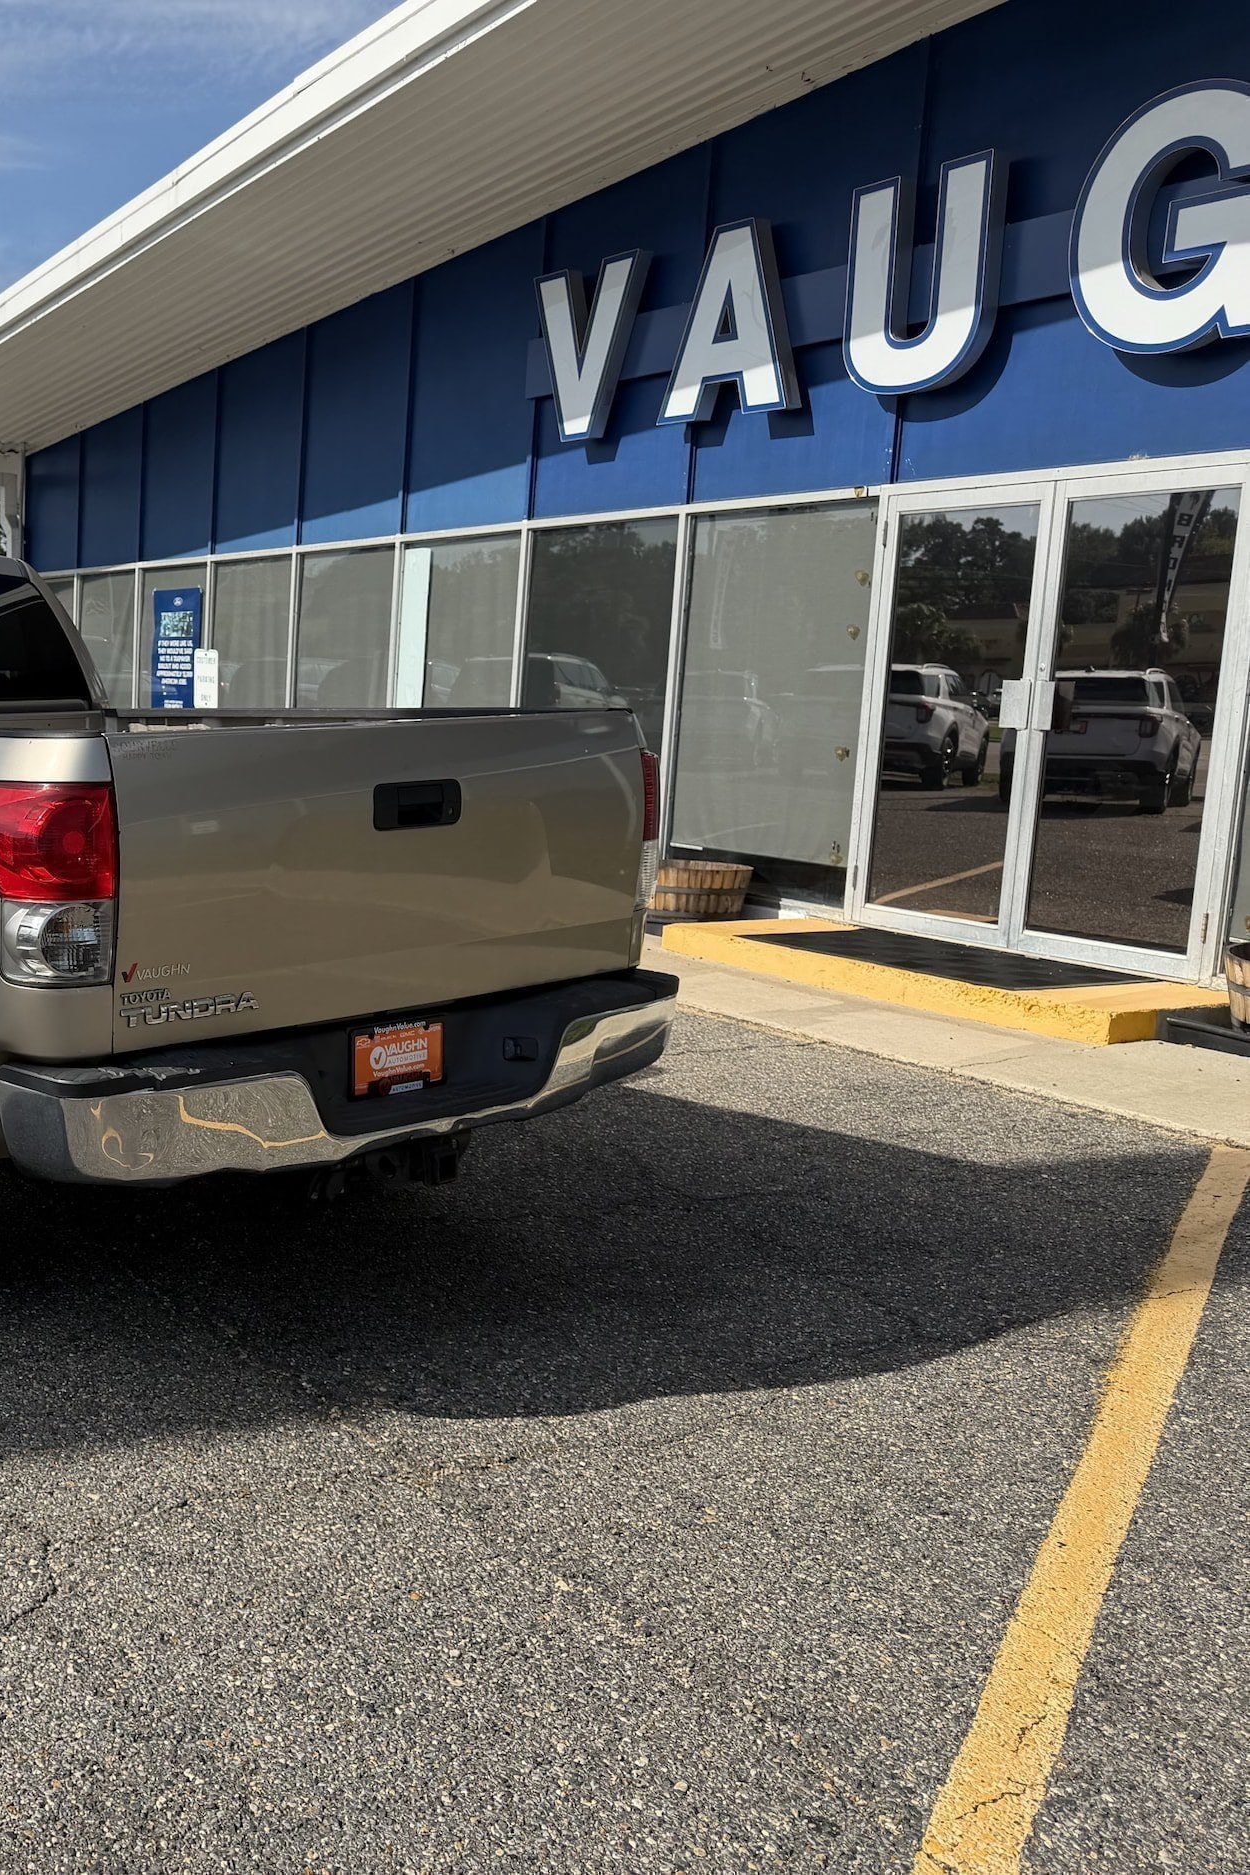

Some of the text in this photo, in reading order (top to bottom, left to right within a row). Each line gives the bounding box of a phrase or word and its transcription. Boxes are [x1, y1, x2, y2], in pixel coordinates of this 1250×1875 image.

[534, 78, 1250, 442] VAUG
[200, 694, 210, 702] ONLY
[136, 963, 191, 981] VAUGHN
[120, 988, 172, 1006] TOYOTA
[120, 990, 260, 1028] TUNDRA
[373, 1021, 427, 1035] VaughnValue.com
[384, 1037, 428, 1056] VAUGHN
[388, 1052, 426, 1065] AUTOMOTIVE
[372, 1062, 425, 1078] VaughnValue.com
